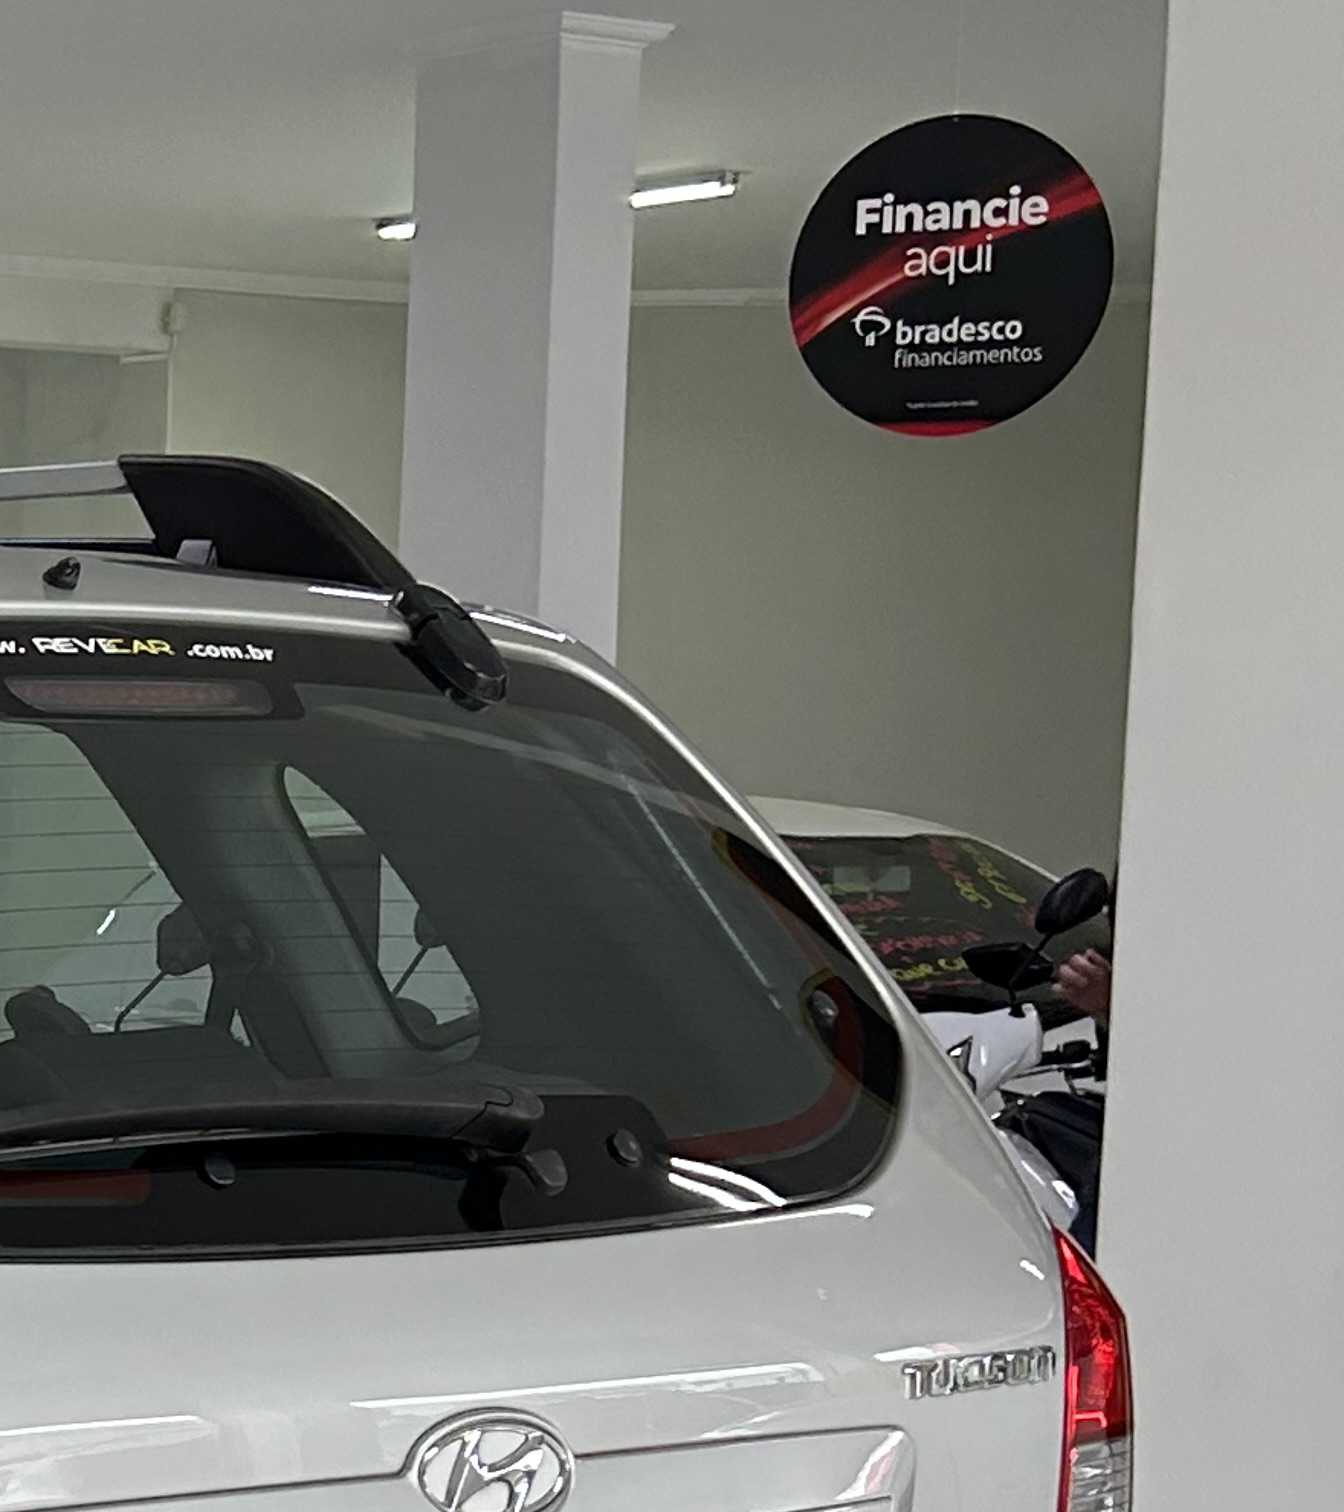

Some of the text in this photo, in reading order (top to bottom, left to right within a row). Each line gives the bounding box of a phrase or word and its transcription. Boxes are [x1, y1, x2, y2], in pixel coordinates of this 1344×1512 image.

[854, 184, 1050, 237] Financie
[902, 232, 994, 286] aqui
[894, 315, 1024, 345] bradesco
[893, 345, 1044, 369] financiamentos
[186, 642, 275, 663] .com.br
